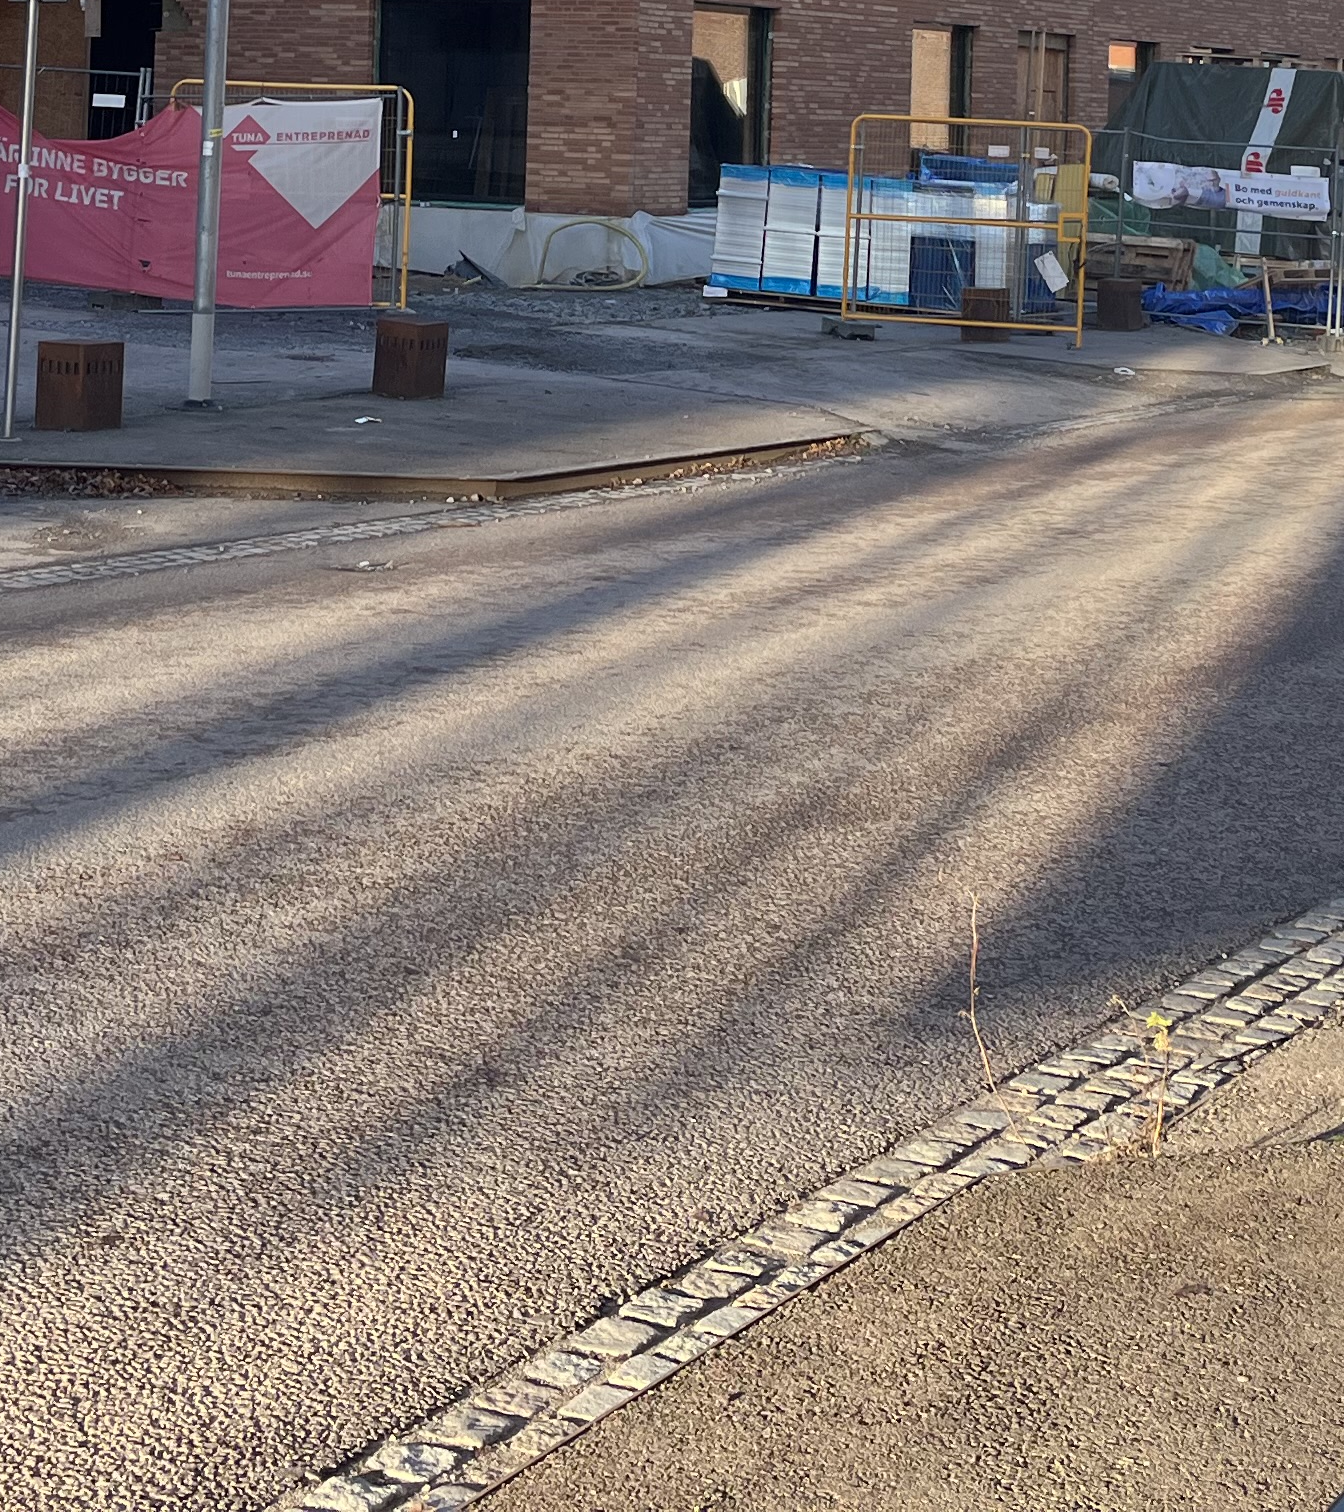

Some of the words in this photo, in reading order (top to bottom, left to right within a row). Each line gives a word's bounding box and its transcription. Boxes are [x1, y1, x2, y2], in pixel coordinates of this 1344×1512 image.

[231, 132, 264, 143] TUNA
[276, 129, 370, 142] ENTREPRENAD
[29, 146, 86, 175] INNE
[92, 158, 189, 188] BYGGER
[54, 181, 125, 211] LIVET
[1234, 183, 1248, 193] Bo
[1250, 187, 1273, 196] med
[1274, 189, 1321, 199] guldkant
[1235, 197, 1254, 205] och
[1256, 199, 1319, 212] gemenskap.
